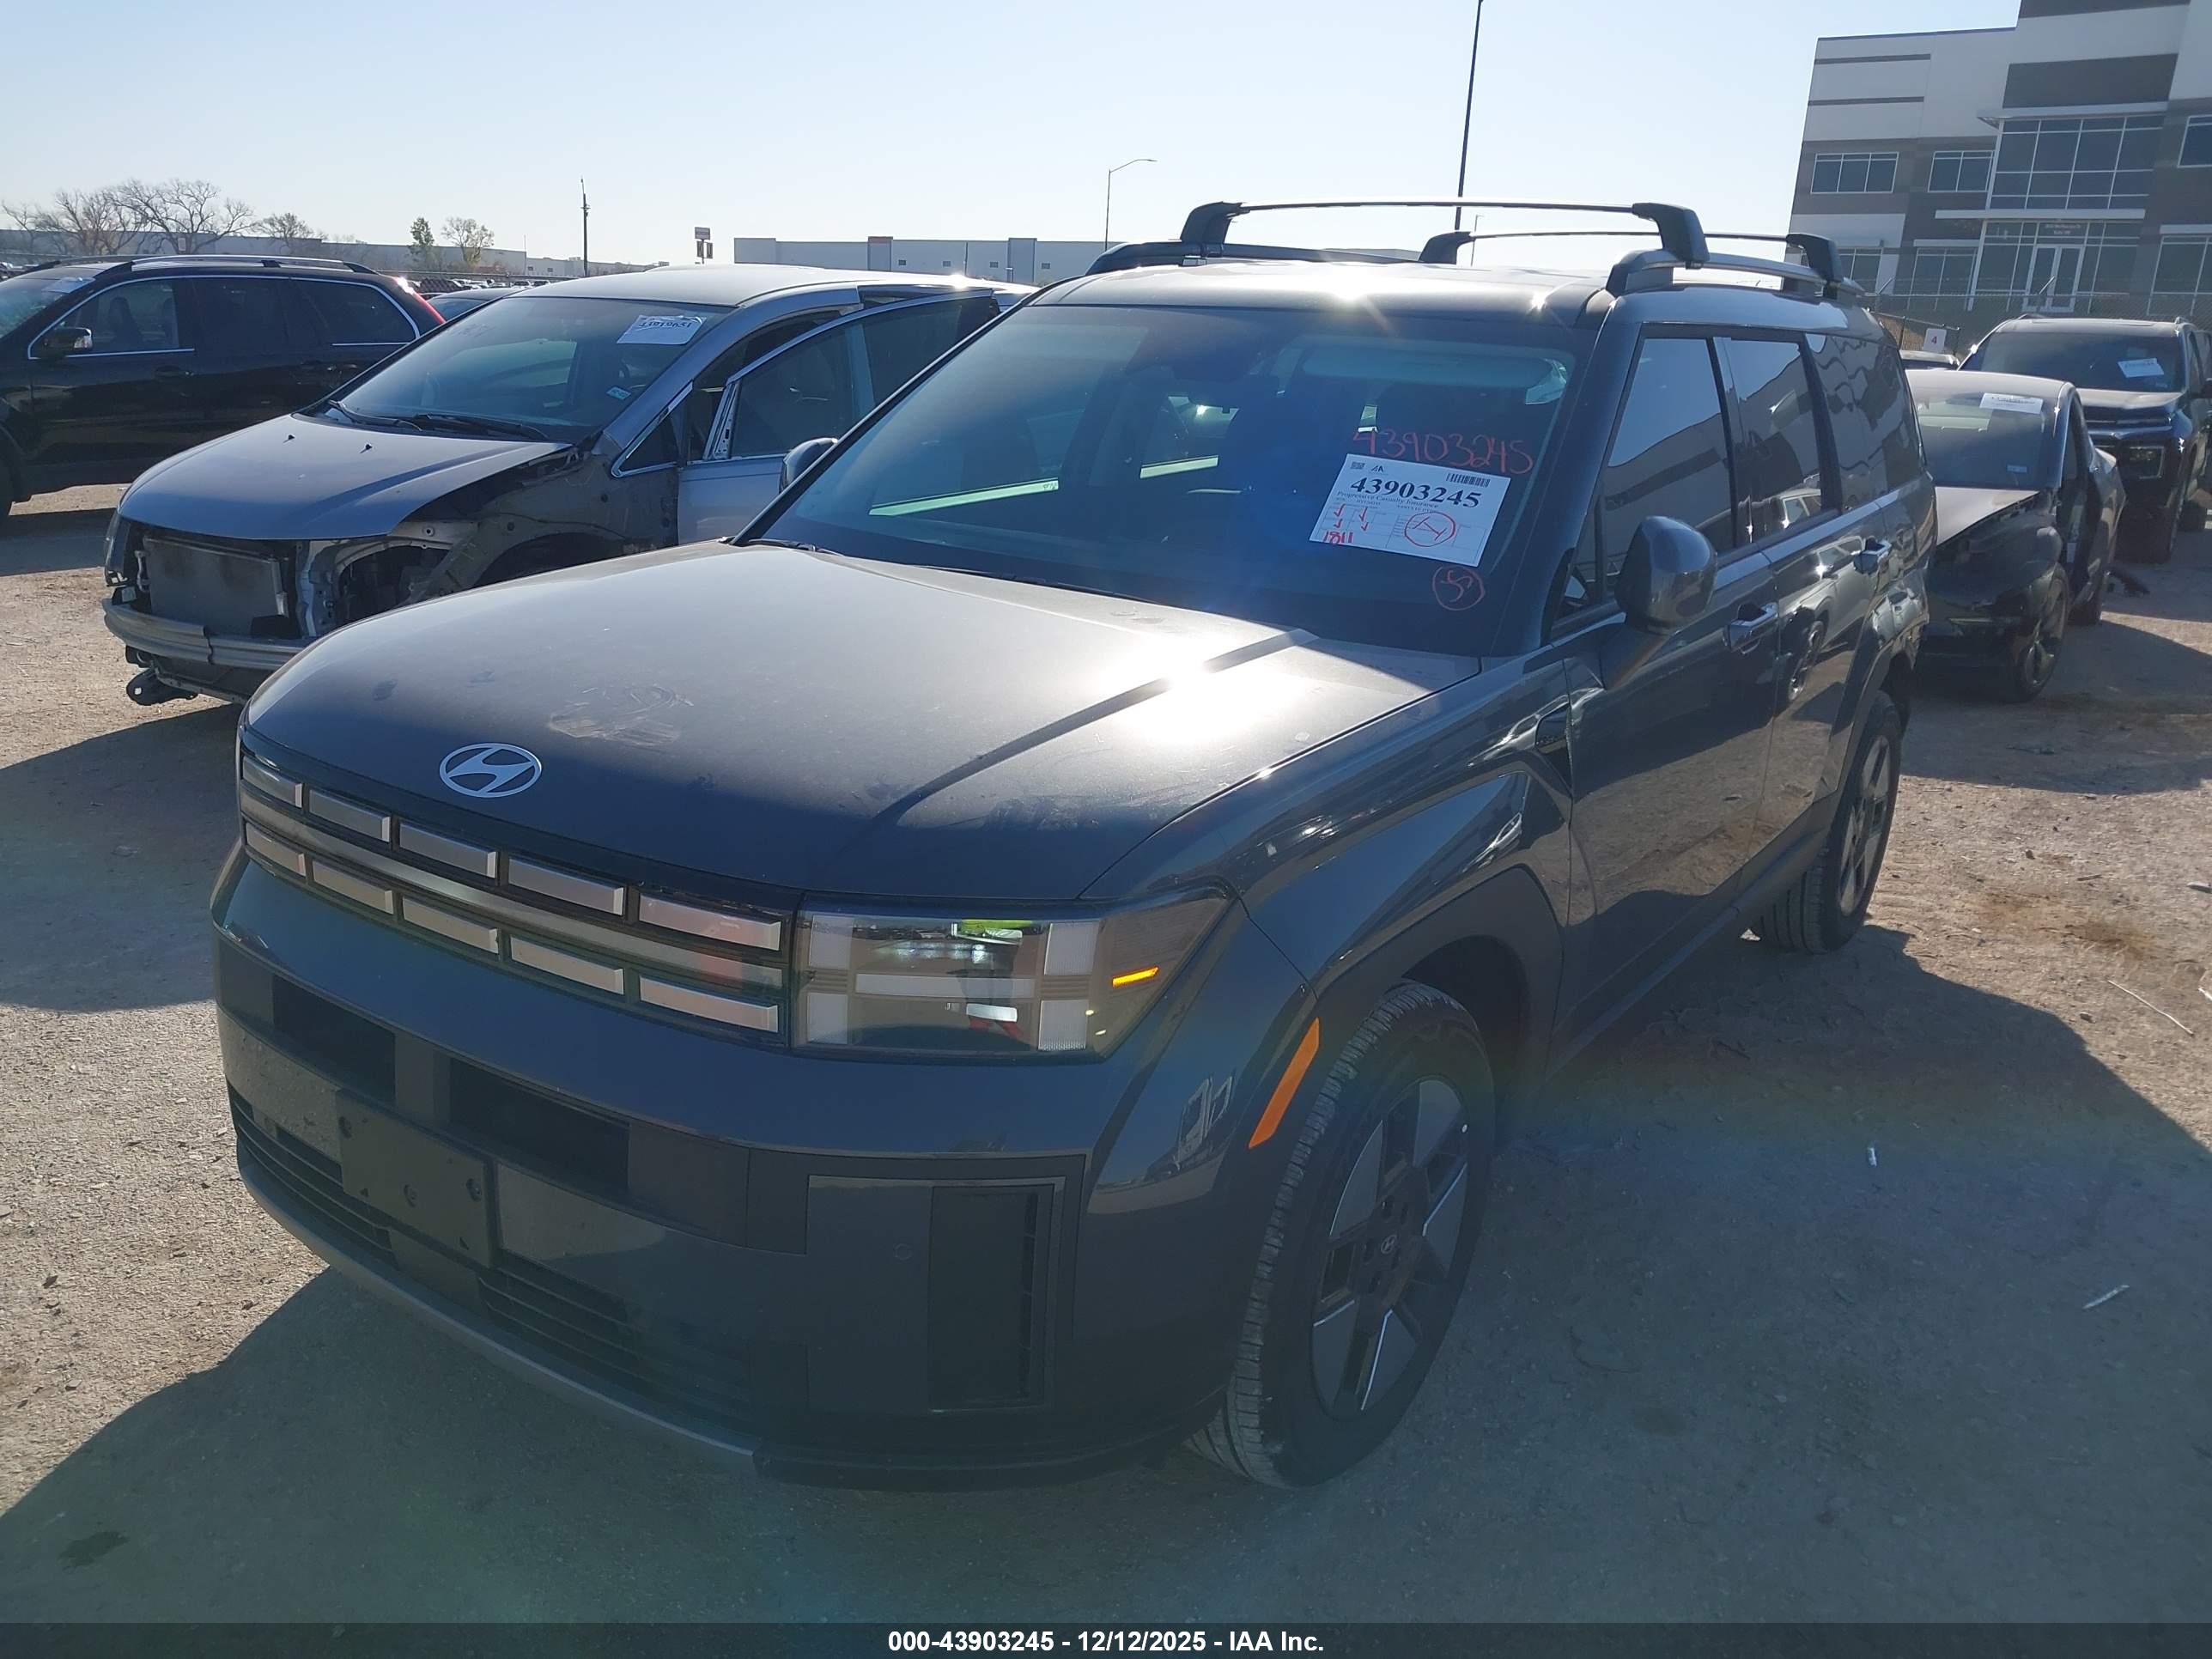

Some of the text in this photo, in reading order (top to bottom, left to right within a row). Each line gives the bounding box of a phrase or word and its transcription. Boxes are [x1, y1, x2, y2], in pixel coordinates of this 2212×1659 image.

[1930, 336, 1937, 344] 4
[1353, 429, 1534, 474] 43903245
[1350, 477, 1482, 508] 43903245
[1376, 495, 1403, 506] Casualty
[1405, 498, 1440, 508] Insurance
